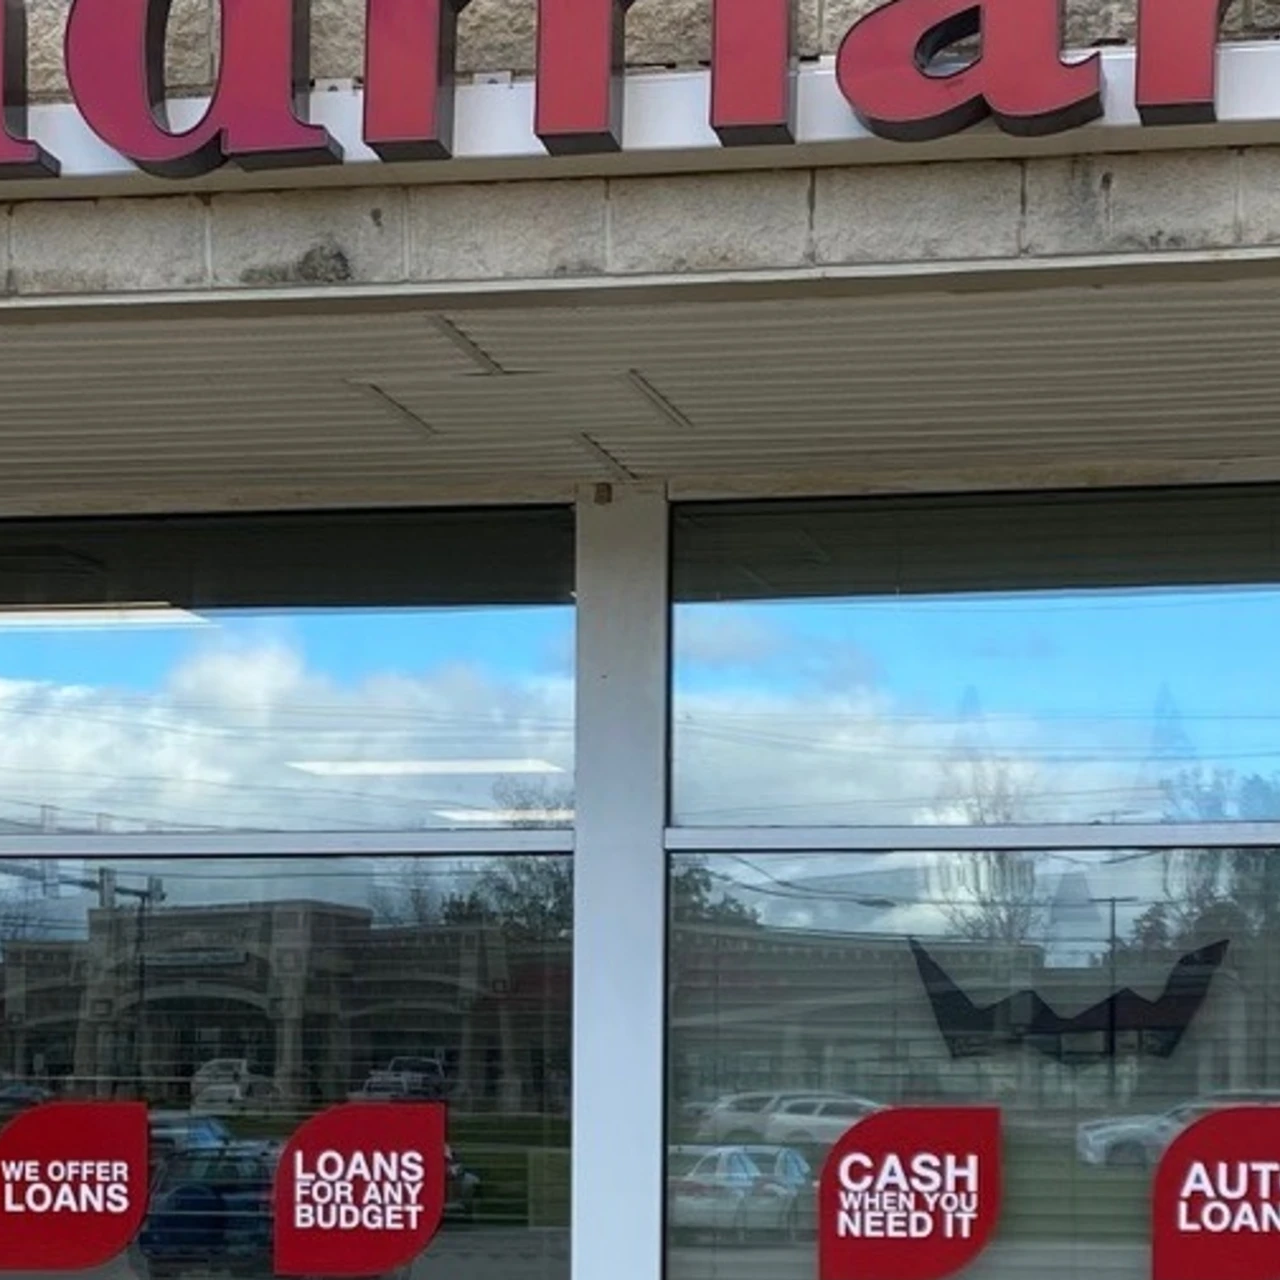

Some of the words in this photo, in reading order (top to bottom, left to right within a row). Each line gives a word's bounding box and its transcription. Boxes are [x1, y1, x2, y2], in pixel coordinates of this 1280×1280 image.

[1, 1160, 38, 1182] WE
[48, 1161, 129, 1182] OFFER
[294, 1151, 425, 1182] LOANS
[838, 1154, 978, 1192] CASH
[4, 1183, 130, 1212] LOANS
[295, 1182, 354, 1204] FOR
[362, 1183, 425, 1206] ANY
[840, 1191, 914, 1211] WHEN
[924, 1193, 977, 1212] YOU
[294, 1206, 424, 1230] BUDGET
[837, 1212, 933, 1238] NEED
[944, 1213, 977, 1238] IT
